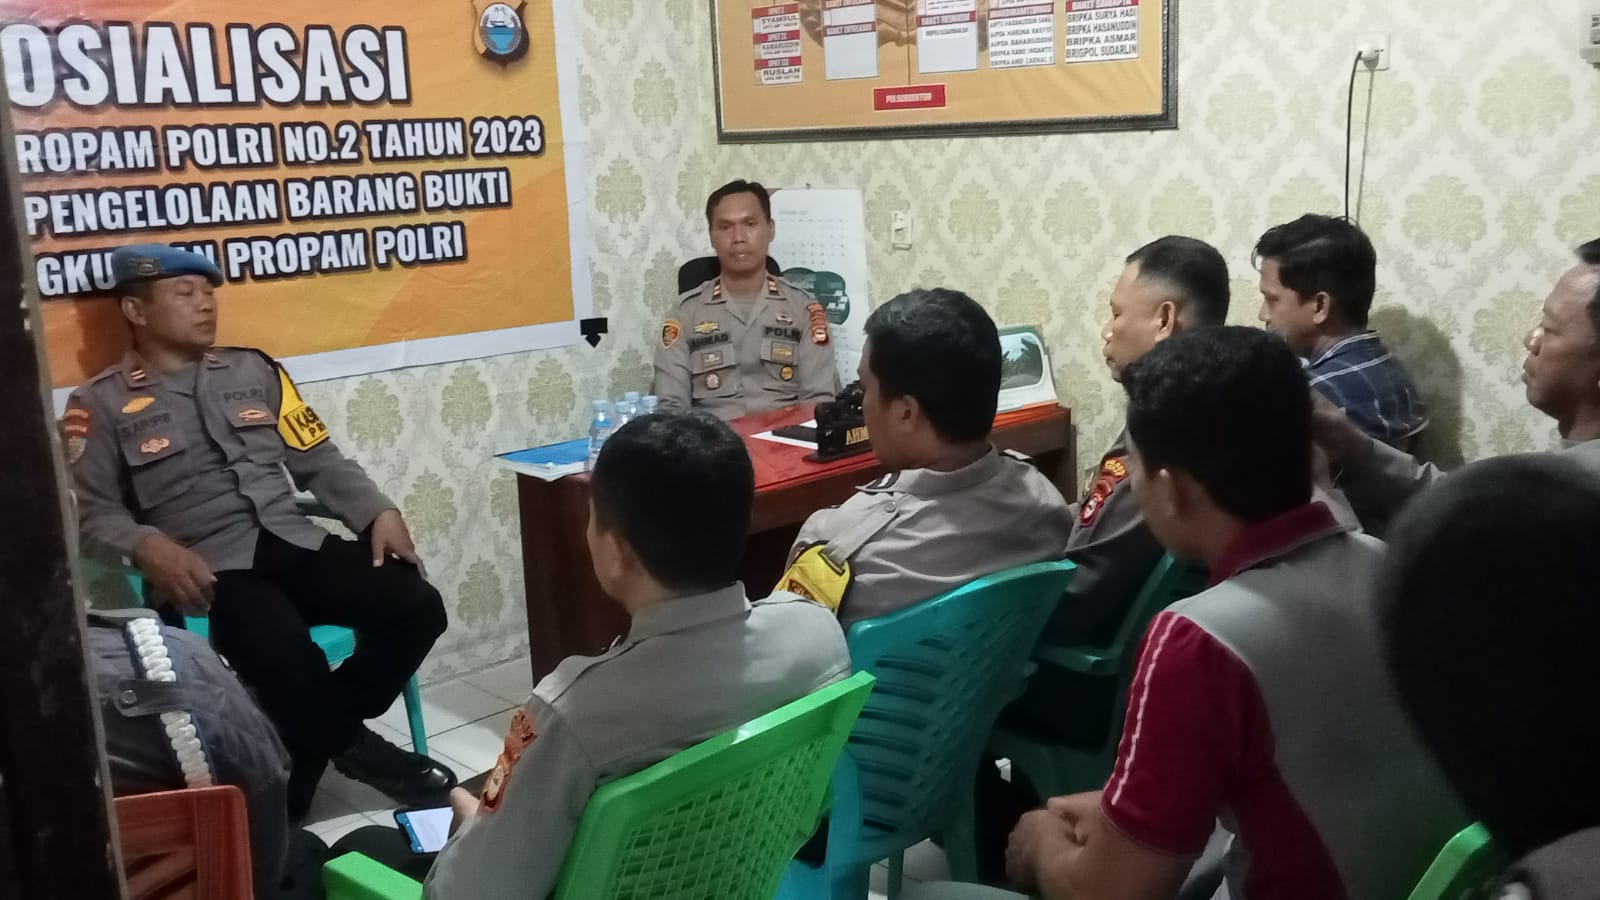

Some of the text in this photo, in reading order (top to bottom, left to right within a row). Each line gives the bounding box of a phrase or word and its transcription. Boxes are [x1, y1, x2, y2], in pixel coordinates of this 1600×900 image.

[1095, 10, 1117, 20] SURYA
[1066, 32, 1136, 46] BRIPKA ASMAR
[1066, 47, 1099, 58] BRIGPOL
[762, 67, 801, 76] RUSLAN
[15, 118, 543, 174] ROPAM POLRI NO.2 TAHUN 2023
[24, 170, 510, 236] PENGELOLAAN BARANG BUKTI
[227, 233, 367, 279] PROPAM
[376, 224, 464, 266] POLRI
[224, 387, 263, 402] POLRI
